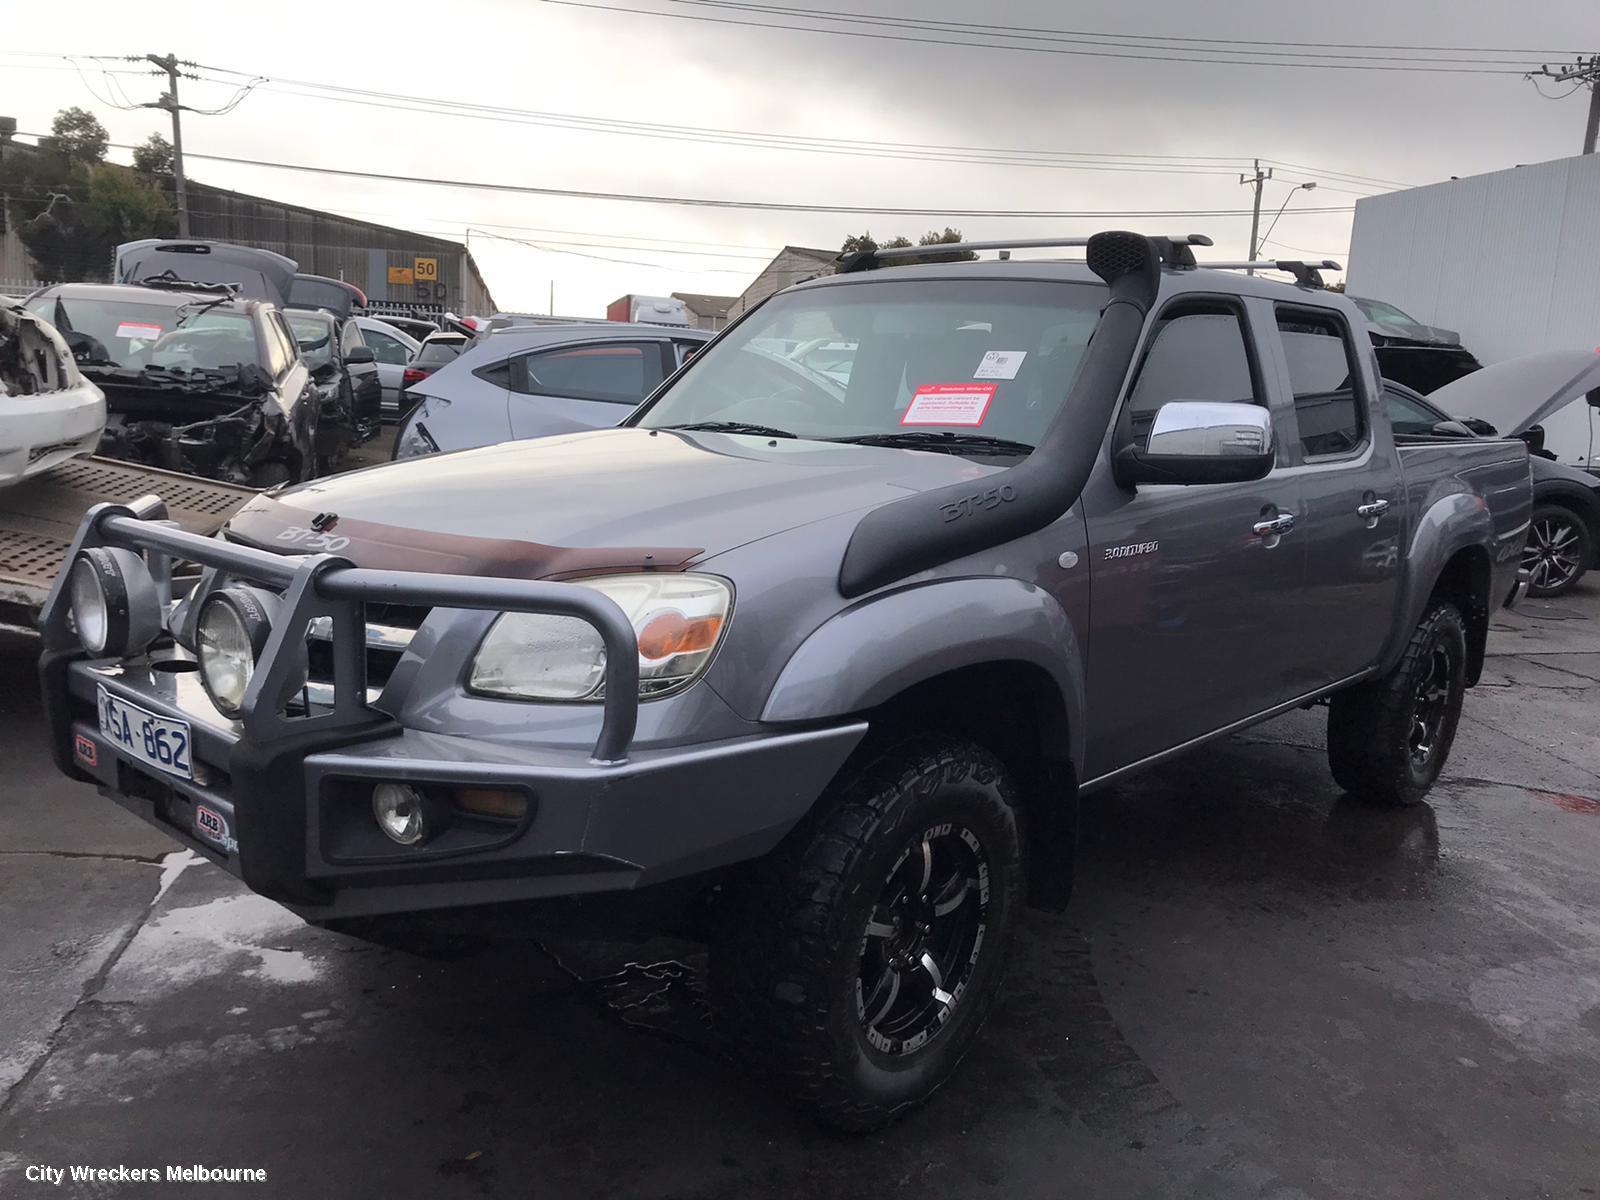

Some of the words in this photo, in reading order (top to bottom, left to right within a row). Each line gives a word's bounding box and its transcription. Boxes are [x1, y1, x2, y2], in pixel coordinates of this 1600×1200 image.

[416, 262, 435, 276] 50
[938, 484, 1018, 524] BT-50
[276, 526, 351, 552] BT-50
[199, 810, 219, 832] ARB
